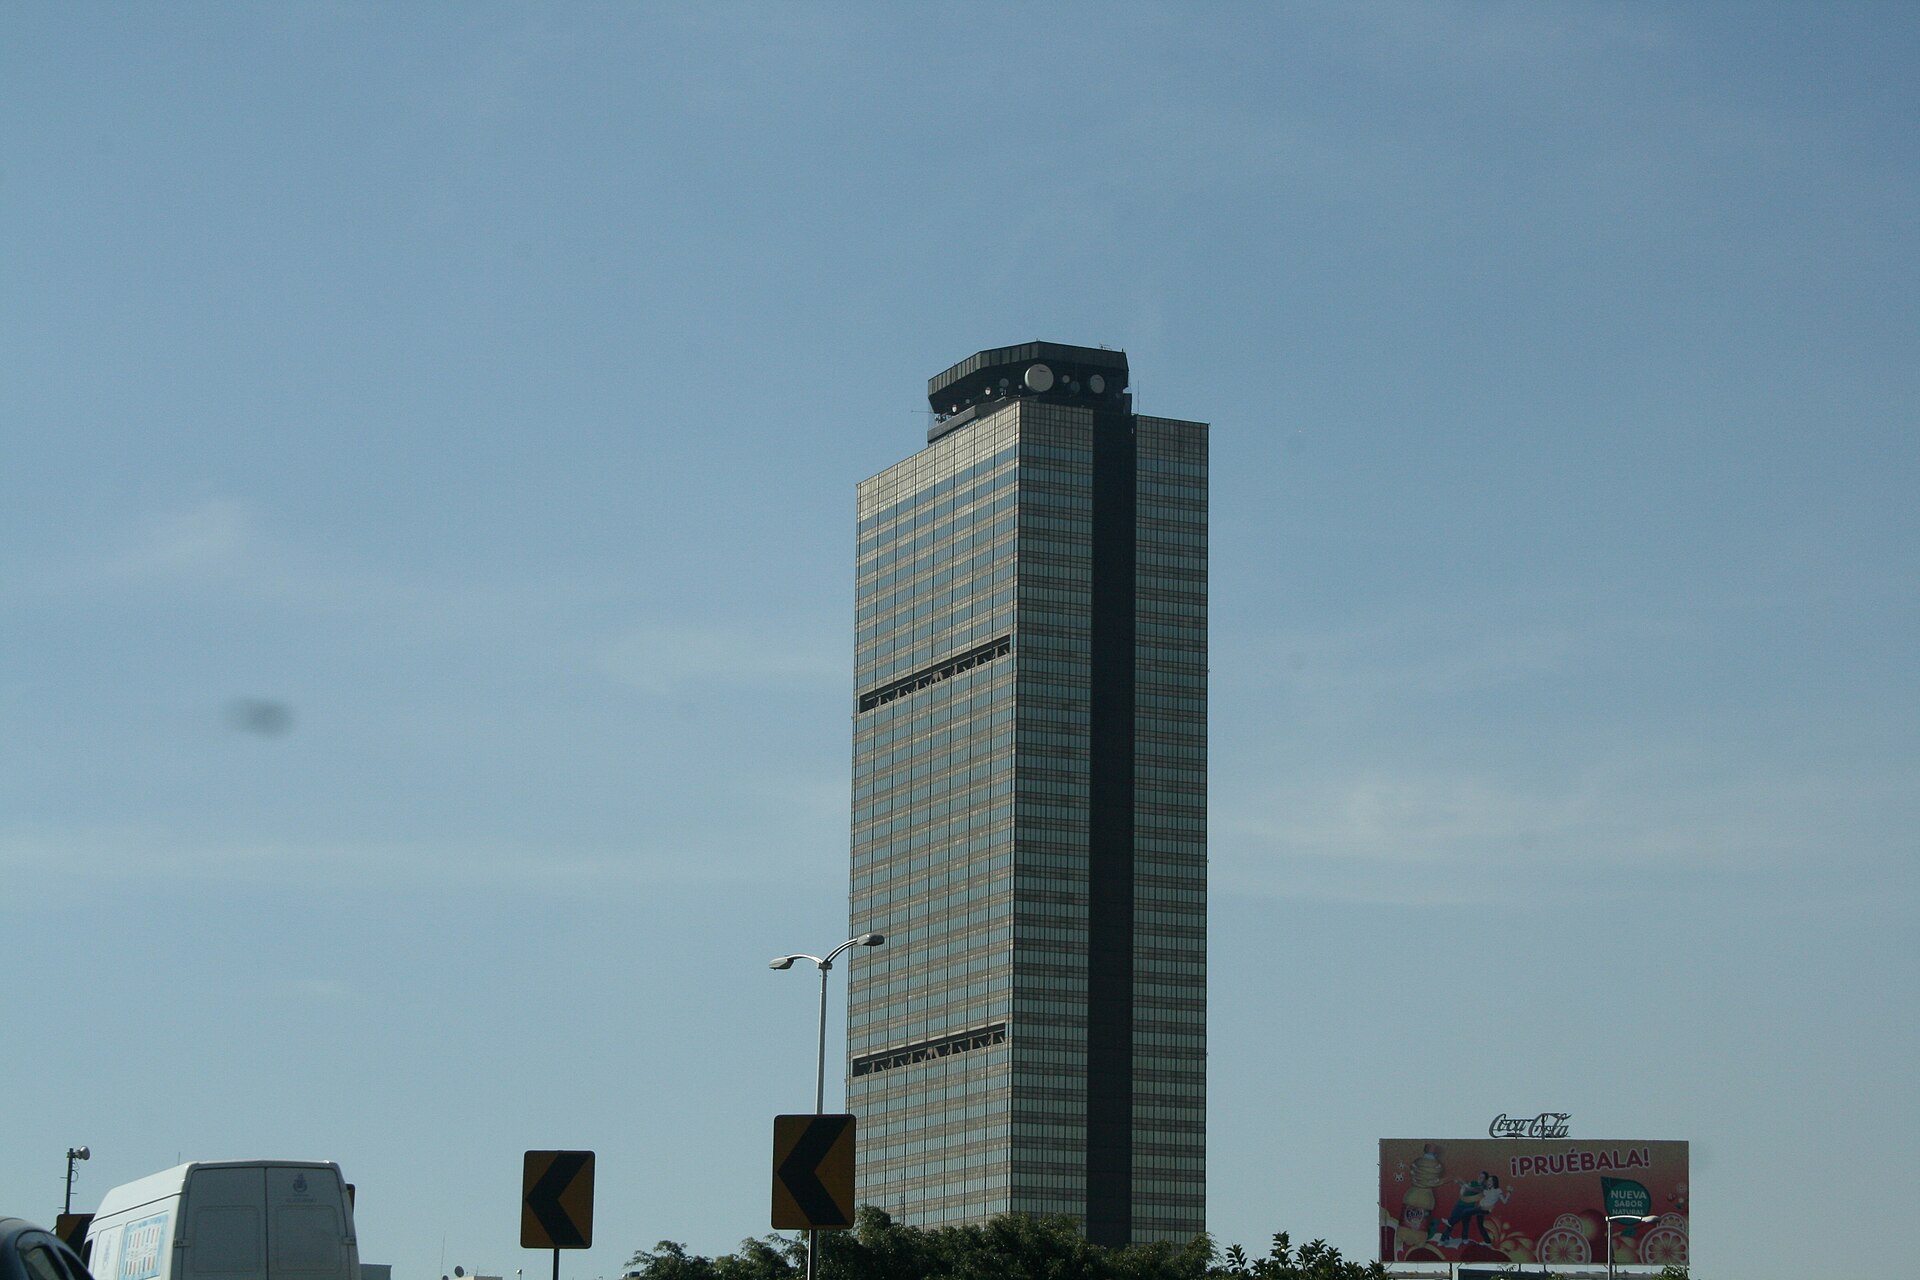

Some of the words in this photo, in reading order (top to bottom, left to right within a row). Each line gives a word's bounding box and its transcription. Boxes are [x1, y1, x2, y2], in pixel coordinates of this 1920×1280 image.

[1511, 1148, 1650, 1176] ¡PRUÉBALA!
[1610, 1190, 1647, 1200] NUEVA
[1614, 1200, 1643, 1208] SABOR
